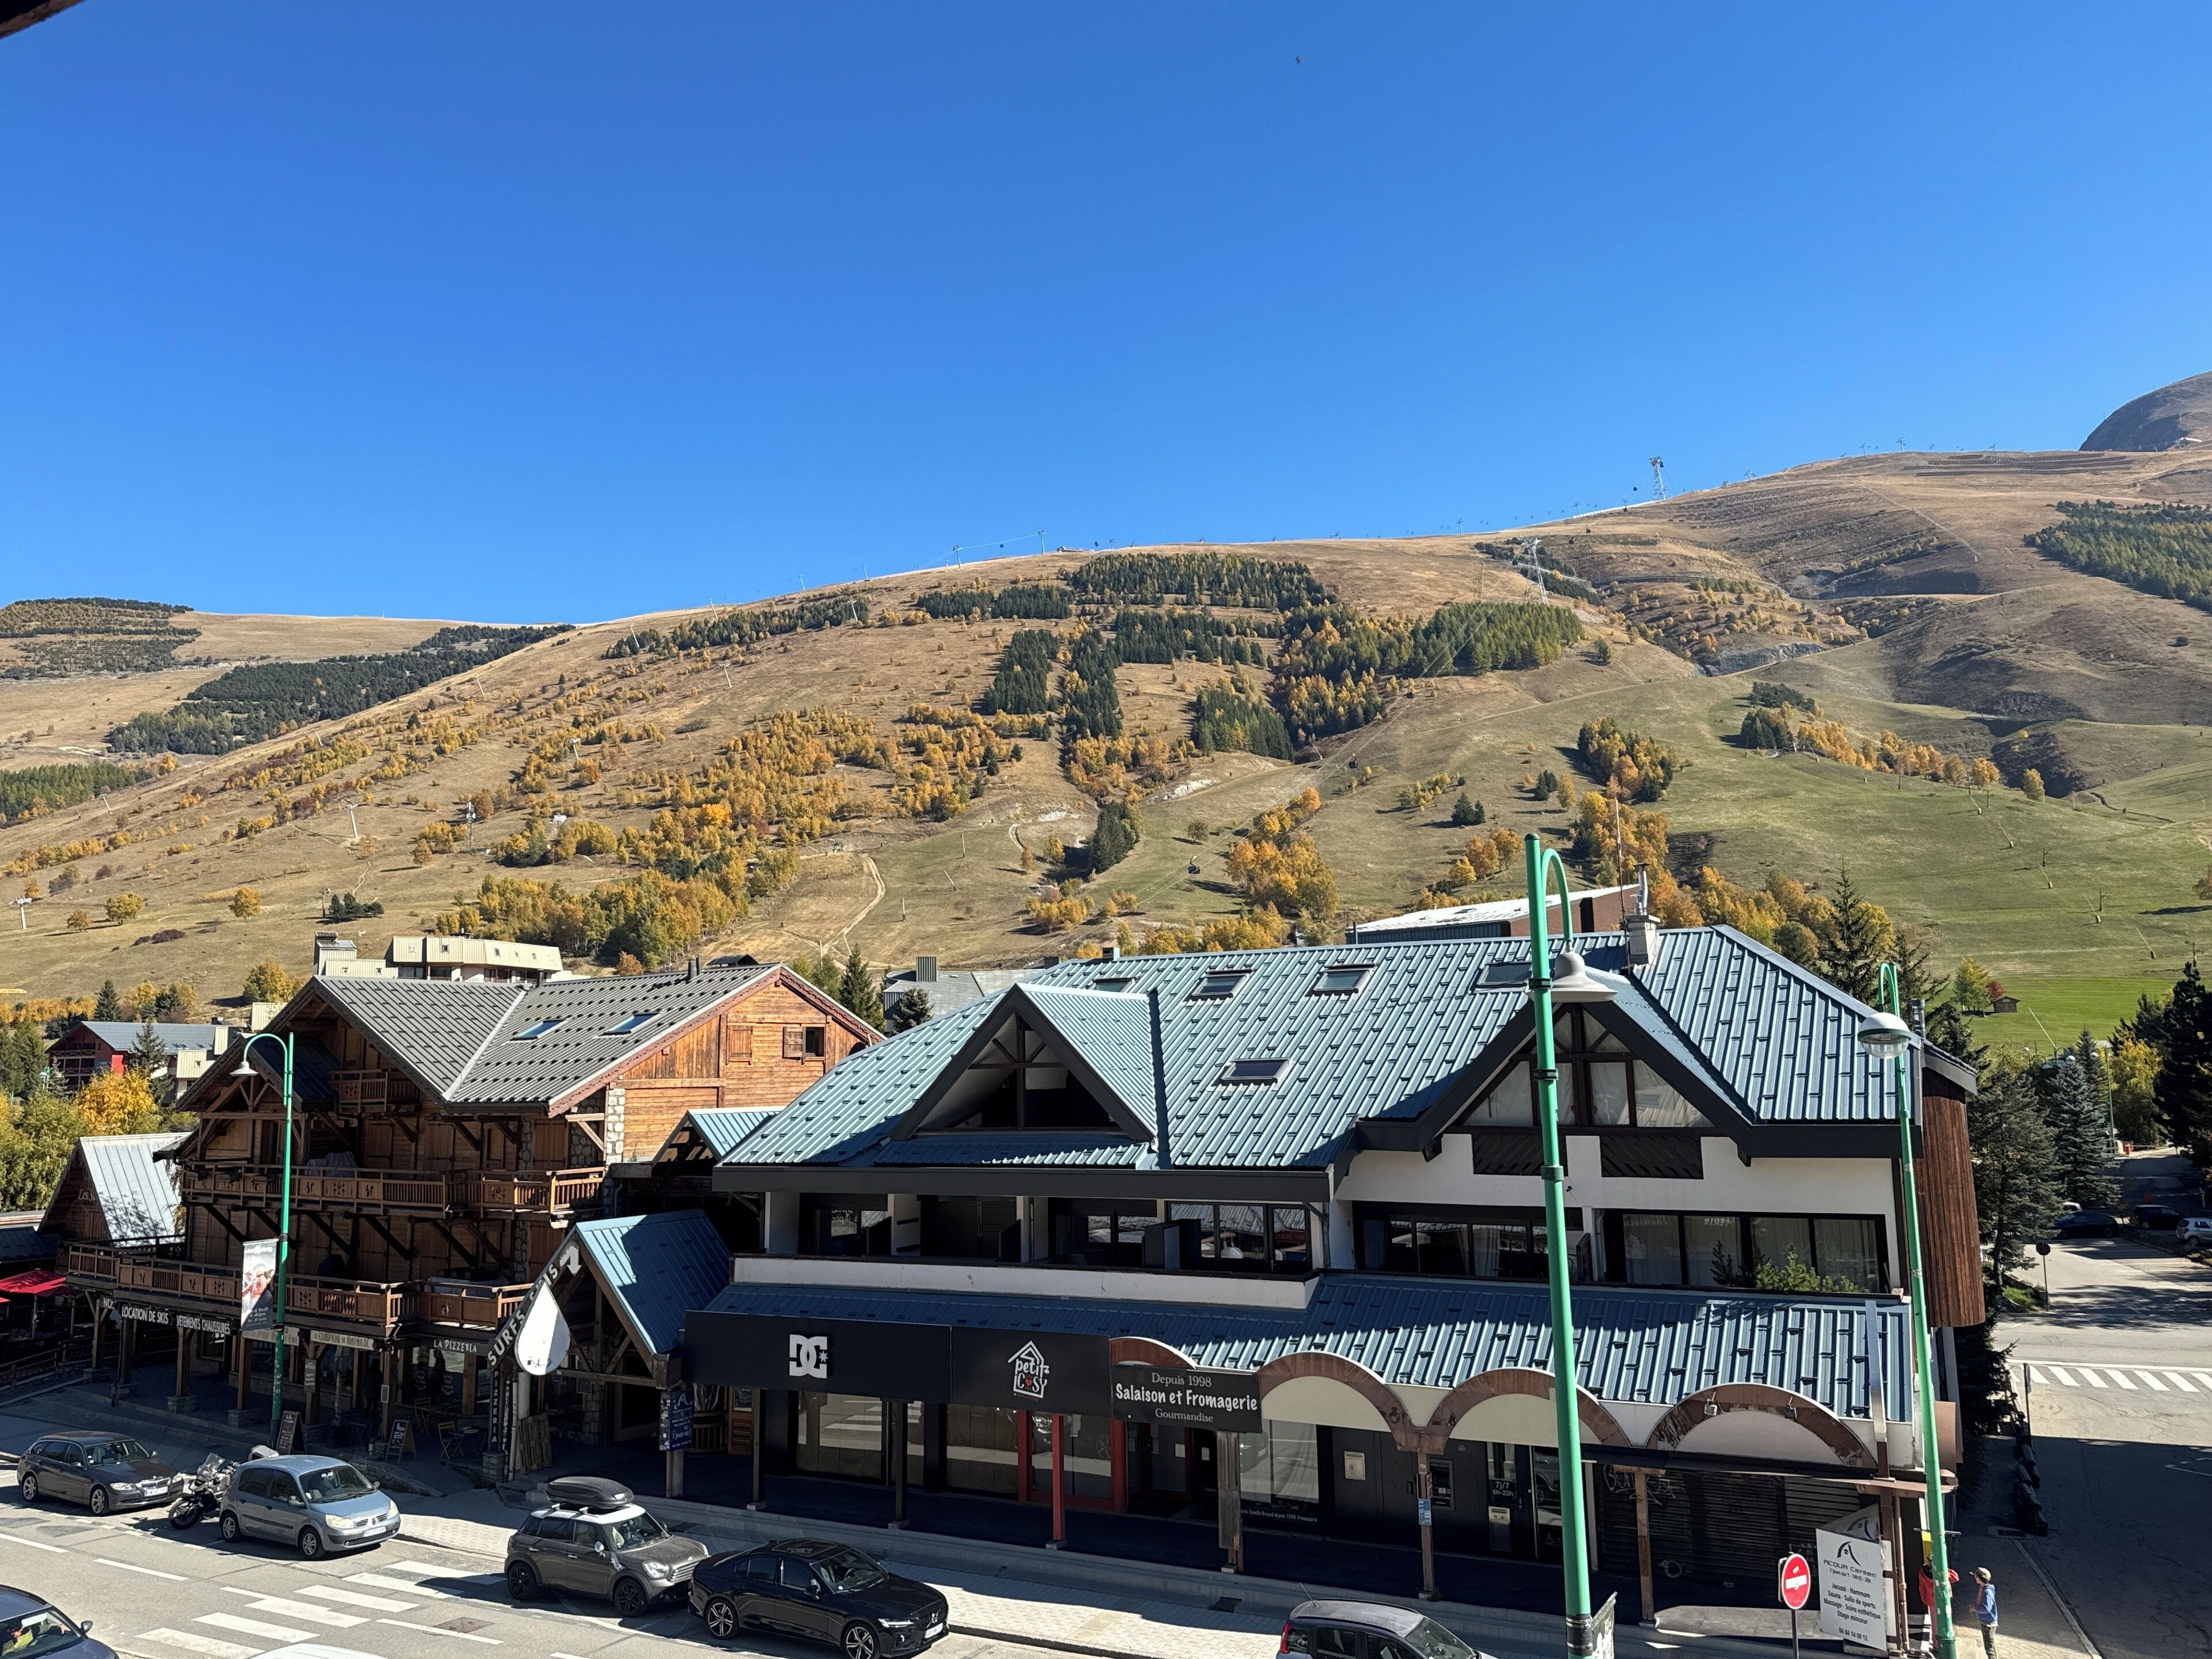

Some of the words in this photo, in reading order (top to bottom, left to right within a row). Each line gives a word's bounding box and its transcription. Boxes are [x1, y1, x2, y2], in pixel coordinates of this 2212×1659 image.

[529, 1264, 559, 1301] SIS
[122, 1306, 148, 1321] LOCATION
[149, 1310, 156, 1323] DE
[157, 1312, 169, 1324] SKIS
[176, 1315, 201, 1330] VETEMENTS
[202, 1319, 230, 1335] CHAUSSURES
[347, 1336, 369, 1348] MATHILDE
[434, 1339, 442, 1348] LA
[444, 1339, 477, 1353] PIZZERIA
[487, 1309, 526, 1366] SURFS
[789, 1334, 828, 1378] DC
[1152, 1372, 1185, 1387] Depuis
[1188, 1375, 1212, 1387] 1998
[1116, 1382, 1166, 1404] Salaison
[1169, 1390, 1183, 1405] et
[1186, 1389, 1257, 1412] Fromagerie
[1155, 1408, 1214, 1422] Gourmandise
[1297, 1514, 1317, 1522] Fromagerie
[1828, 1590, 1841, 1599] Sauna
[1844, 1594, 1855, 1603] Salle
[1862, 1601, 1876, 1609] sports
[1832, 1583, 1847, 1592] Jacuzzi
[1850, 1588, 1871, 1599] Hammam
[1824, 1597, 1842, 1609] Massage
[1845, 1604, 1857, 1612] Soins
[1858, 1608, 1881, 1620] esthétique
[1837, 1610, 1850, 1620] Stage
[1850, 1615, 1868, 1624] minceur
